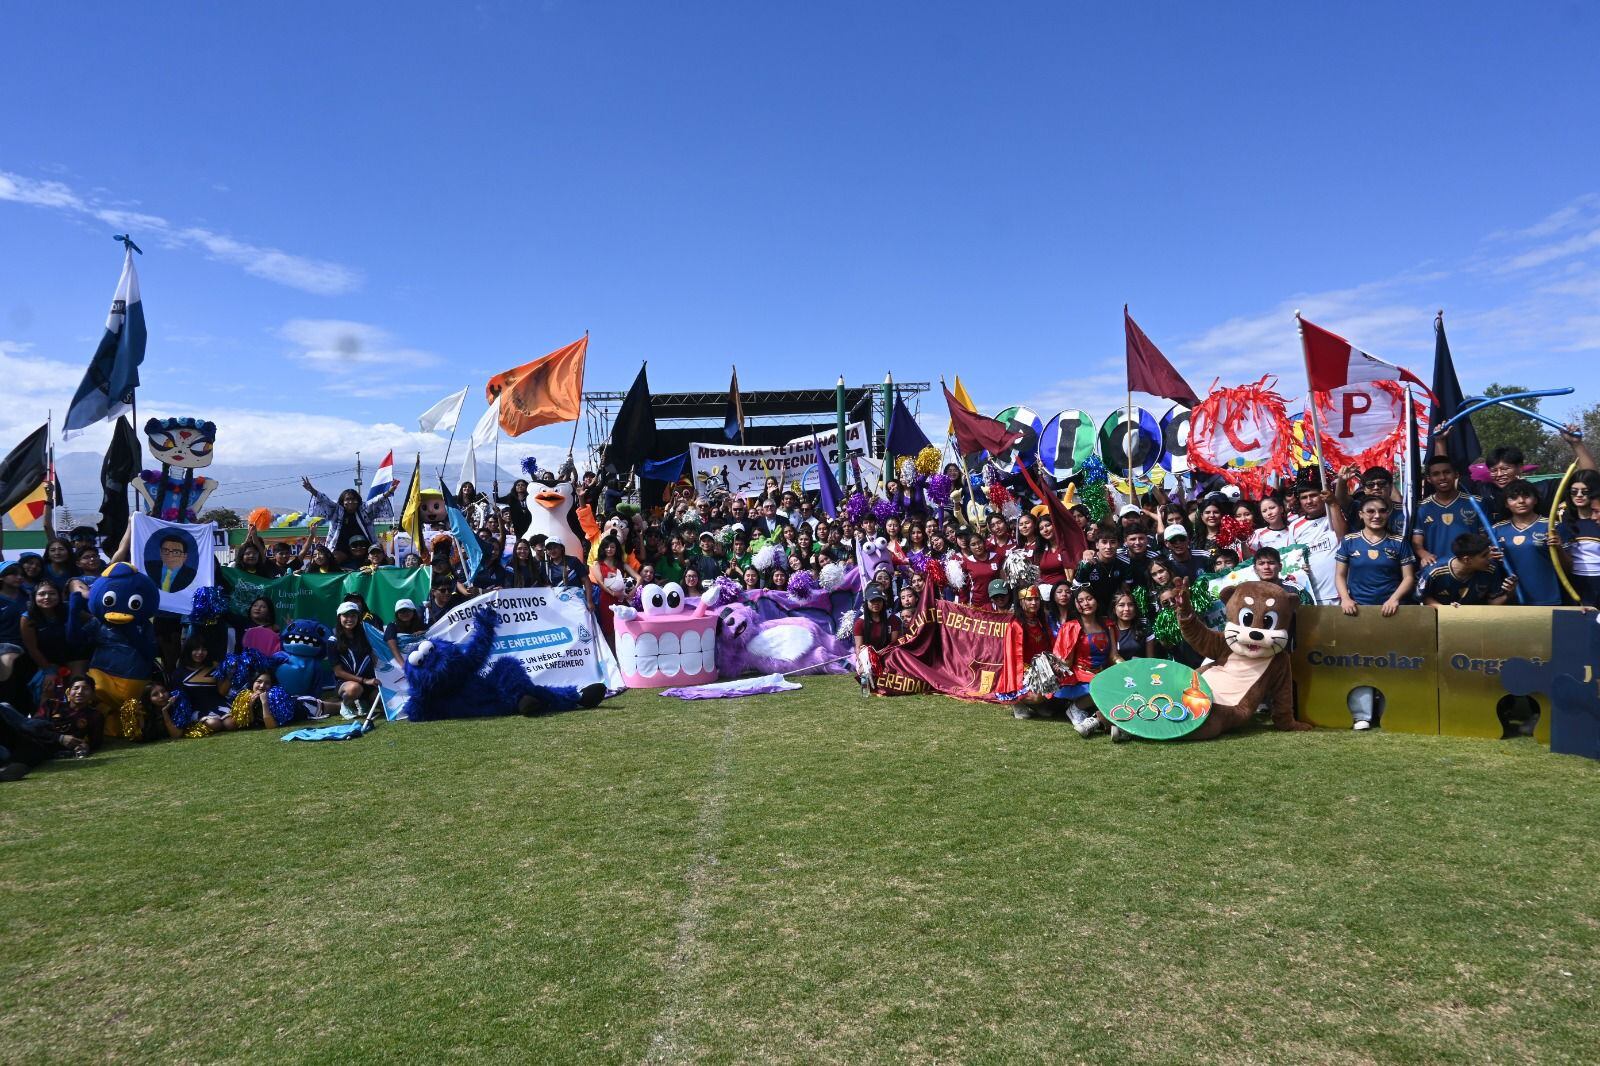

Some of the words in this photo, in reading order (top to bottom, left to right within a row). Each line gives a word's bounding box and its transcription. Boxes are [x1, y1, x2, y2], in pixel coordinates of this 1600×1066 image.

[1338, 392, 1372, 438] P
[737, 459, 748, 471] Y
[512, 611, 538, 623] 2025
[525, 656, 537, 664] UN
[565, 649, 583, 658] PERO
[1306, 651, 1425, 671] Controlar
[532, 664, 544, 672] UN
[544, 658, 585, 670] ENFERMERO
